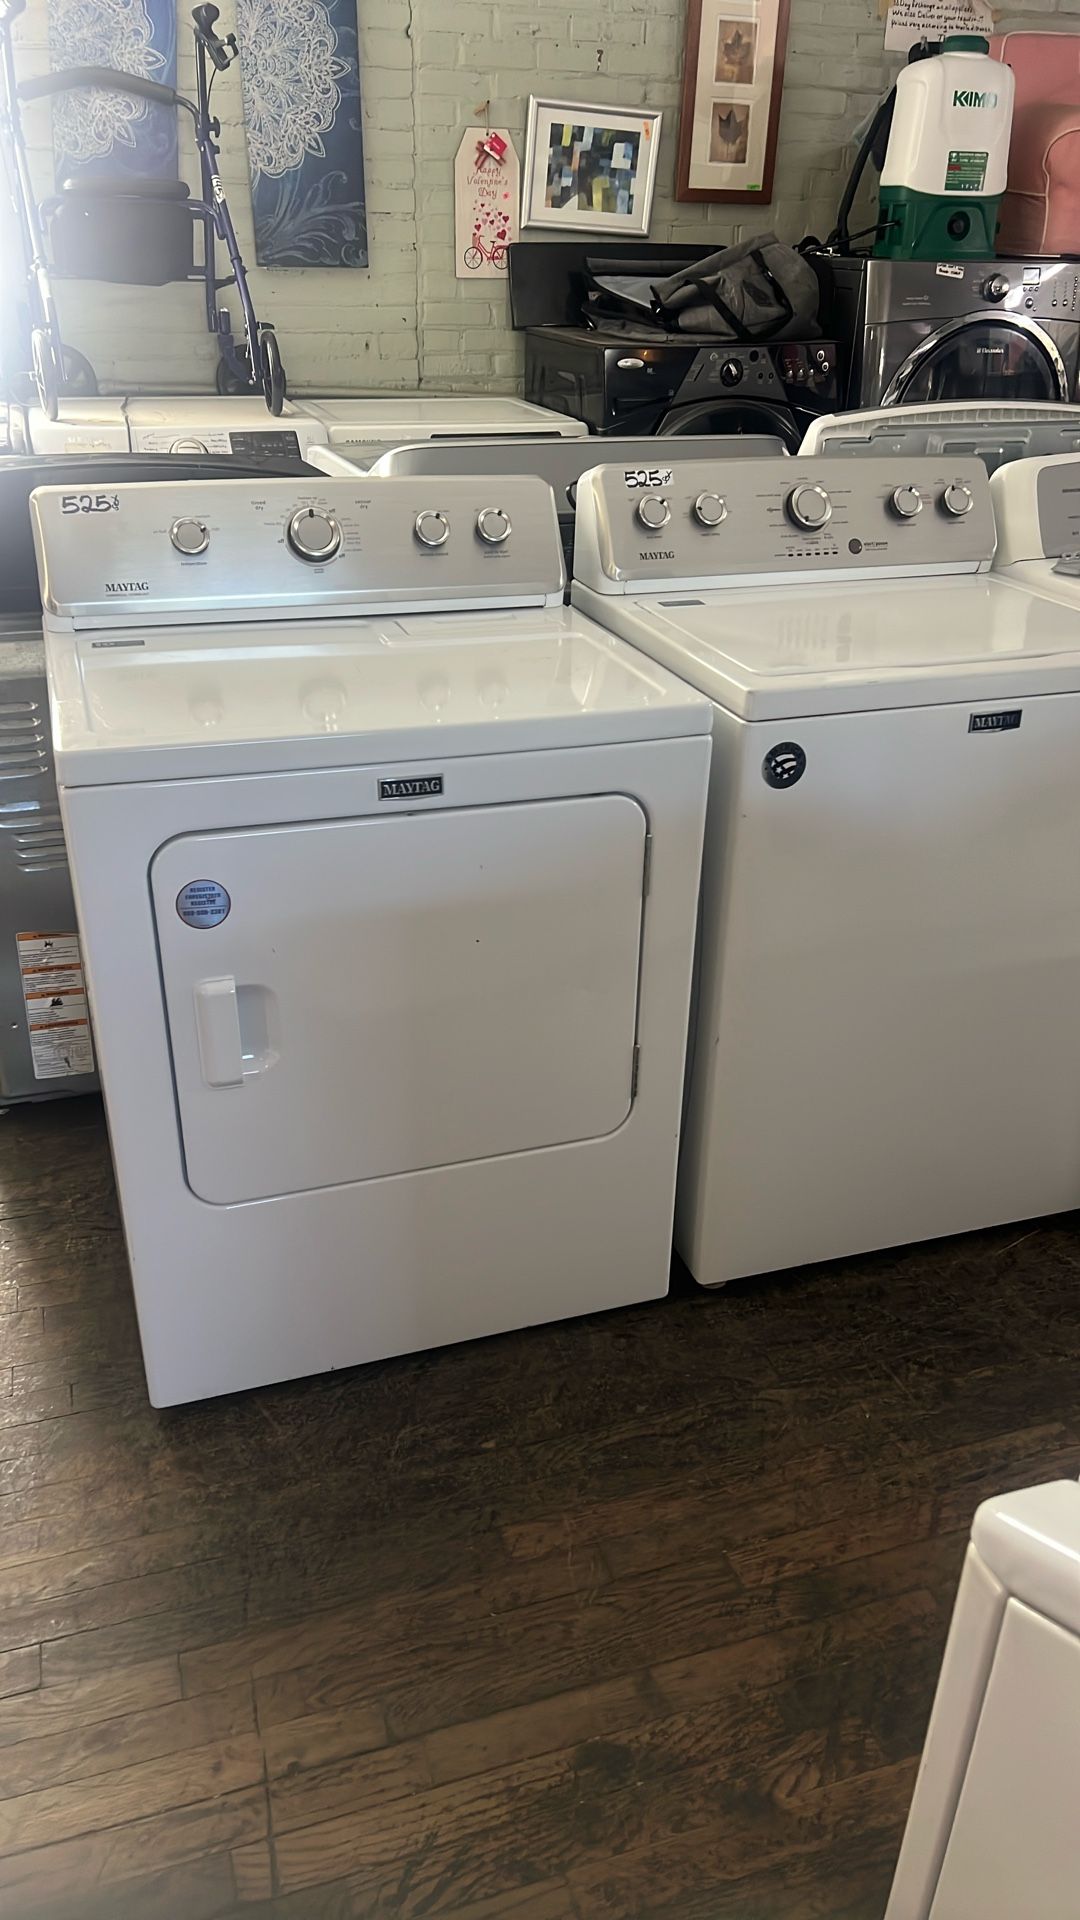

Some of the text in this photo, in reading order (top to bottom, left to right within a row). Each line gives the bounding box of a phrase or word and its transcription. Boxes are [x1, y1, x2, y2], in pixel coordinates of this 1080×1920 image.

[478, 187, 497, 199] Day
[639, 551, 675, 560] MAYTAG
[105, 582, 149, 592] MAYTAG
[383, 780, 440, 796] MAYTAG
